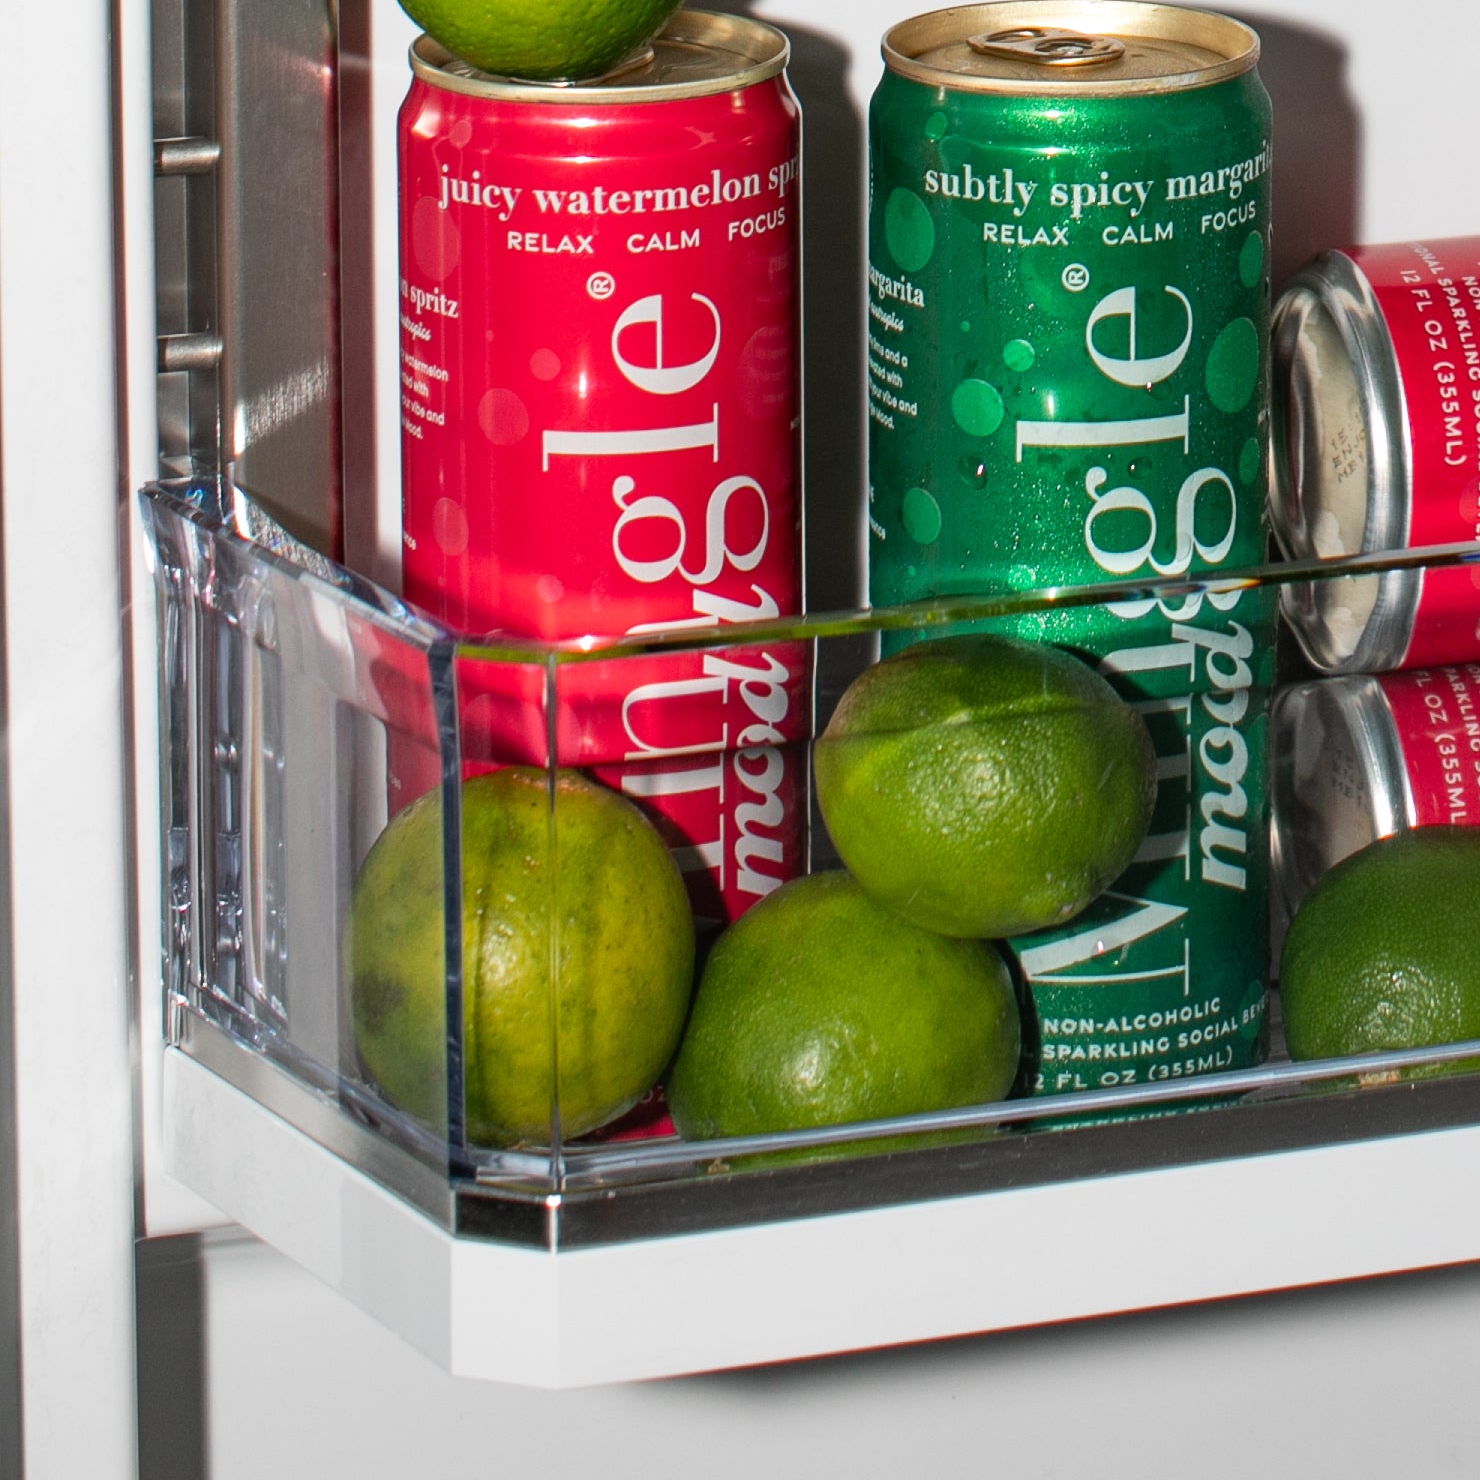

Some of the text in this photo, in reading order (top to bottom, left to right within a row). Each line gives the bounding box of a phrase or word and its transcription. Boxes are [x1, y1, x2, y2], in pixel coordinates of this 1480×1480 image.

[437, 164, 761, 222] juicy watermelon
[923, 163, 1154, 220] subtly spicy
[506, 206, 786, 254] RELAX CALM FOCUS
[983, 199, 1256, 247] RELAX CALM FOCUS
[409, 286, 460, 319] spritz
[1400, 269, 1467, 467] 12 FL OZ (355ML)
[426, 409, 446, 427] and
[898, 398, 919, 417] and
[692, 583, 790, 898] mood
[1170, 619, 1256, 891] mood
[1423, 693, 1468, 825] OZ (355ML
[1043, 996, 1222, 1035] NON-ALCOHOLIC
[1043, 1015, 1239, 1061] SPARKLING SOCIAL
[1056, 1044, 1233, 1090] FL OZ (355ML)
